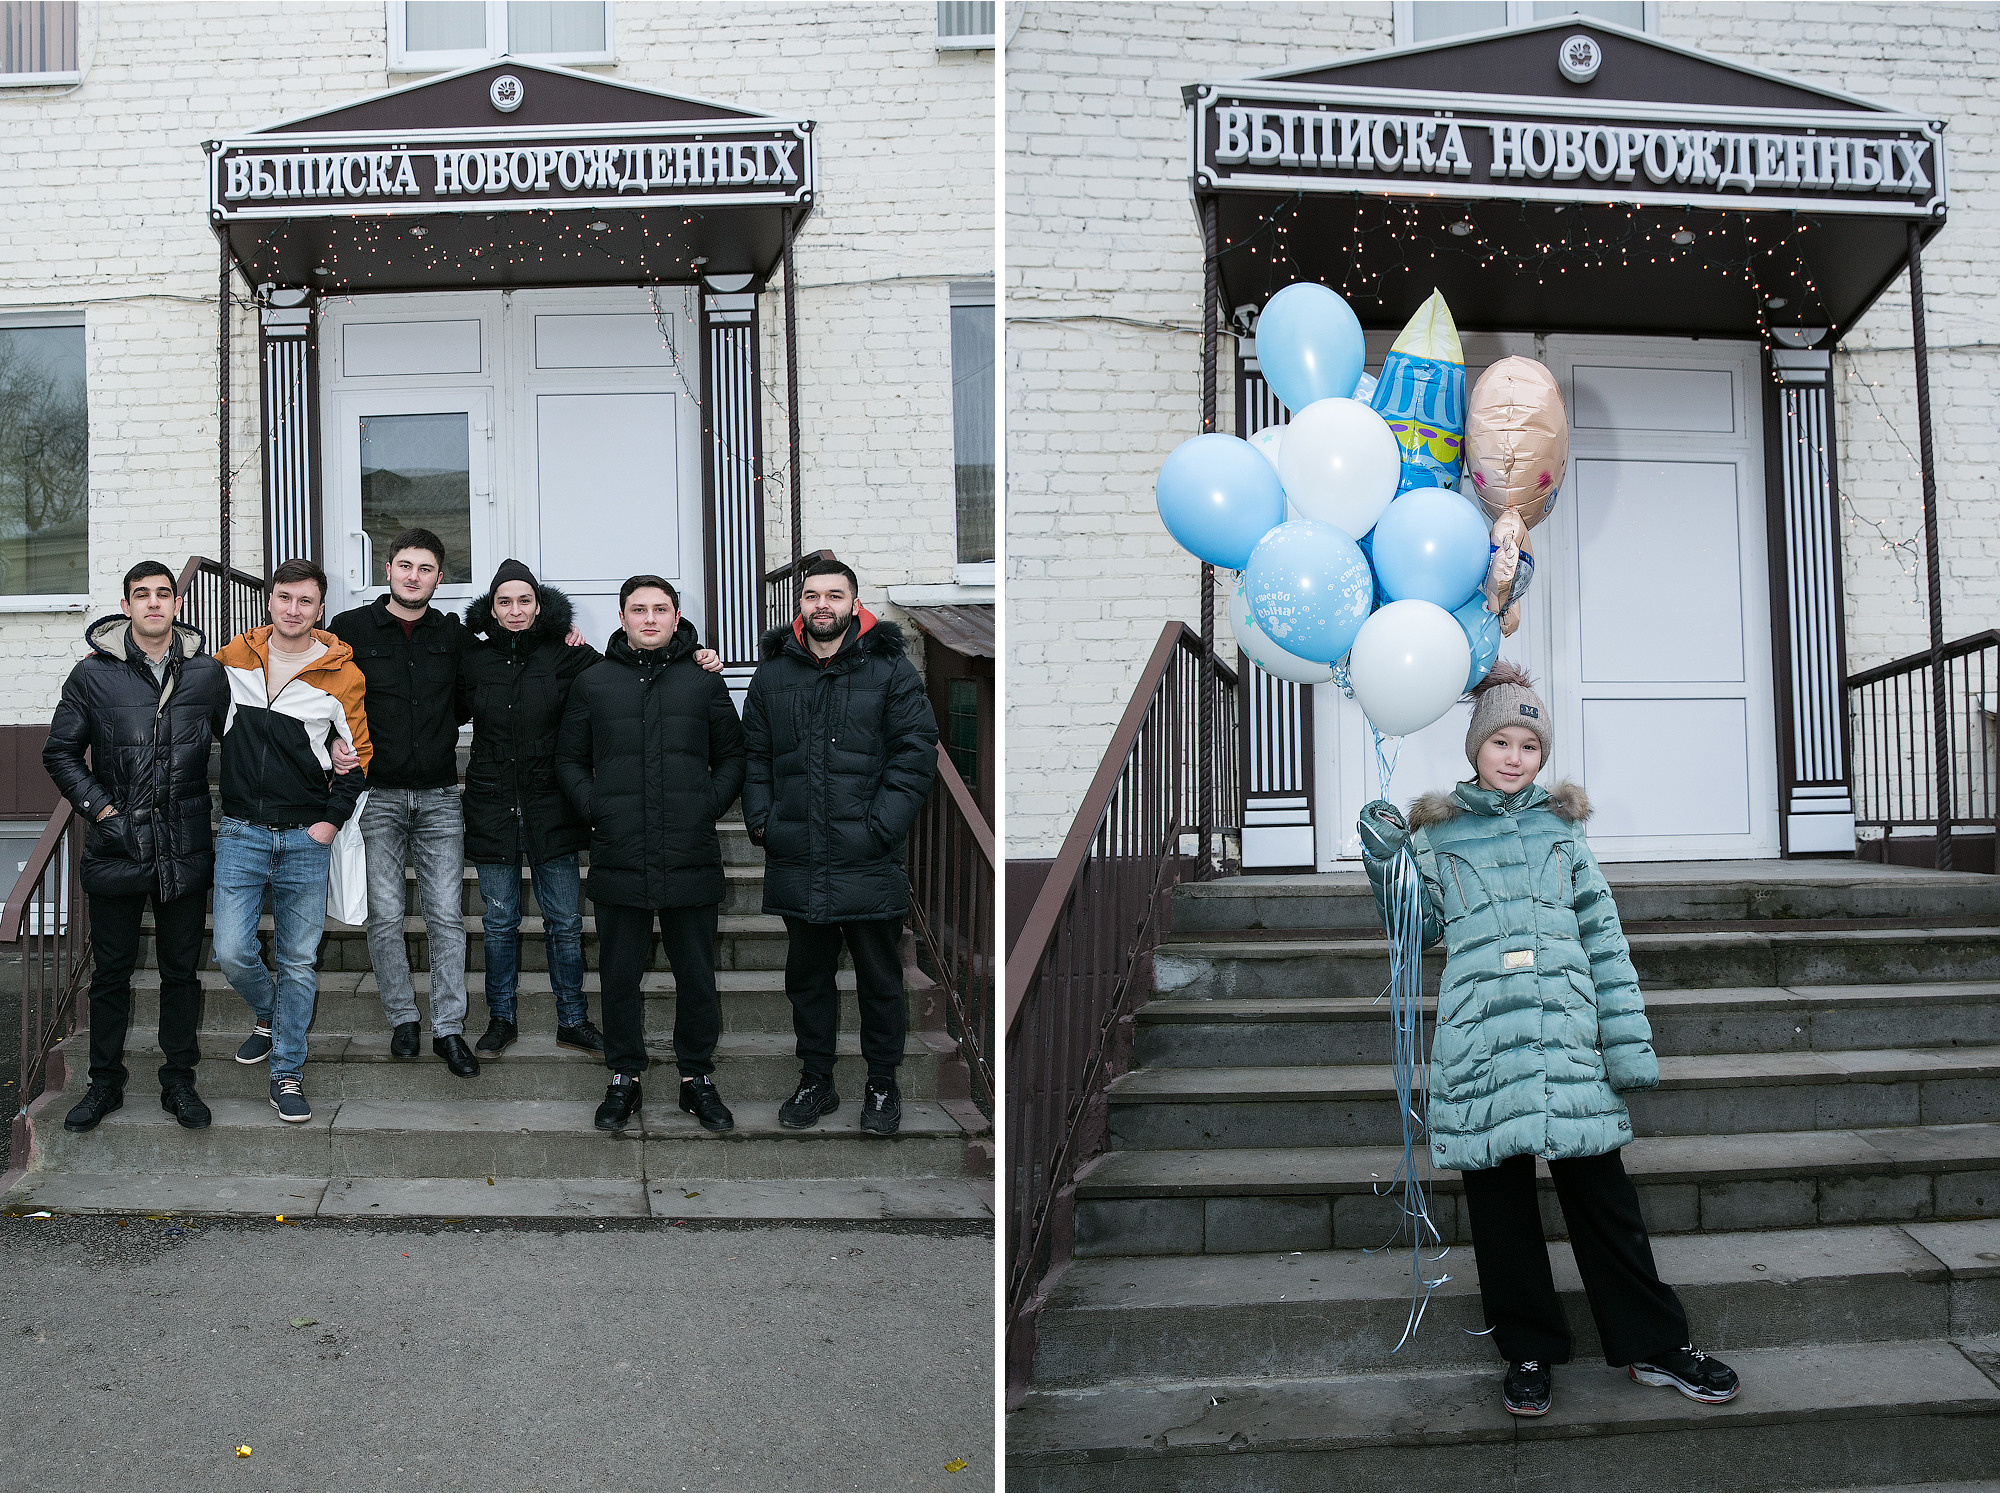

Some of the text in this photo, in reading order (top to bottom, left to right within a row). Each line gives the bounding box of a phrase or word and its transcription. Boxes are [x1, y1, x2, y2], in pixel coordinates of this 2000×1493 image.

[225, 140, 799, 199] ВЫПИСКА НОВОРОЖДЕННЫХ
[1215, 106, 1932, 195] ВЫПИСКА НОВОРОЖДЕННЫХ
